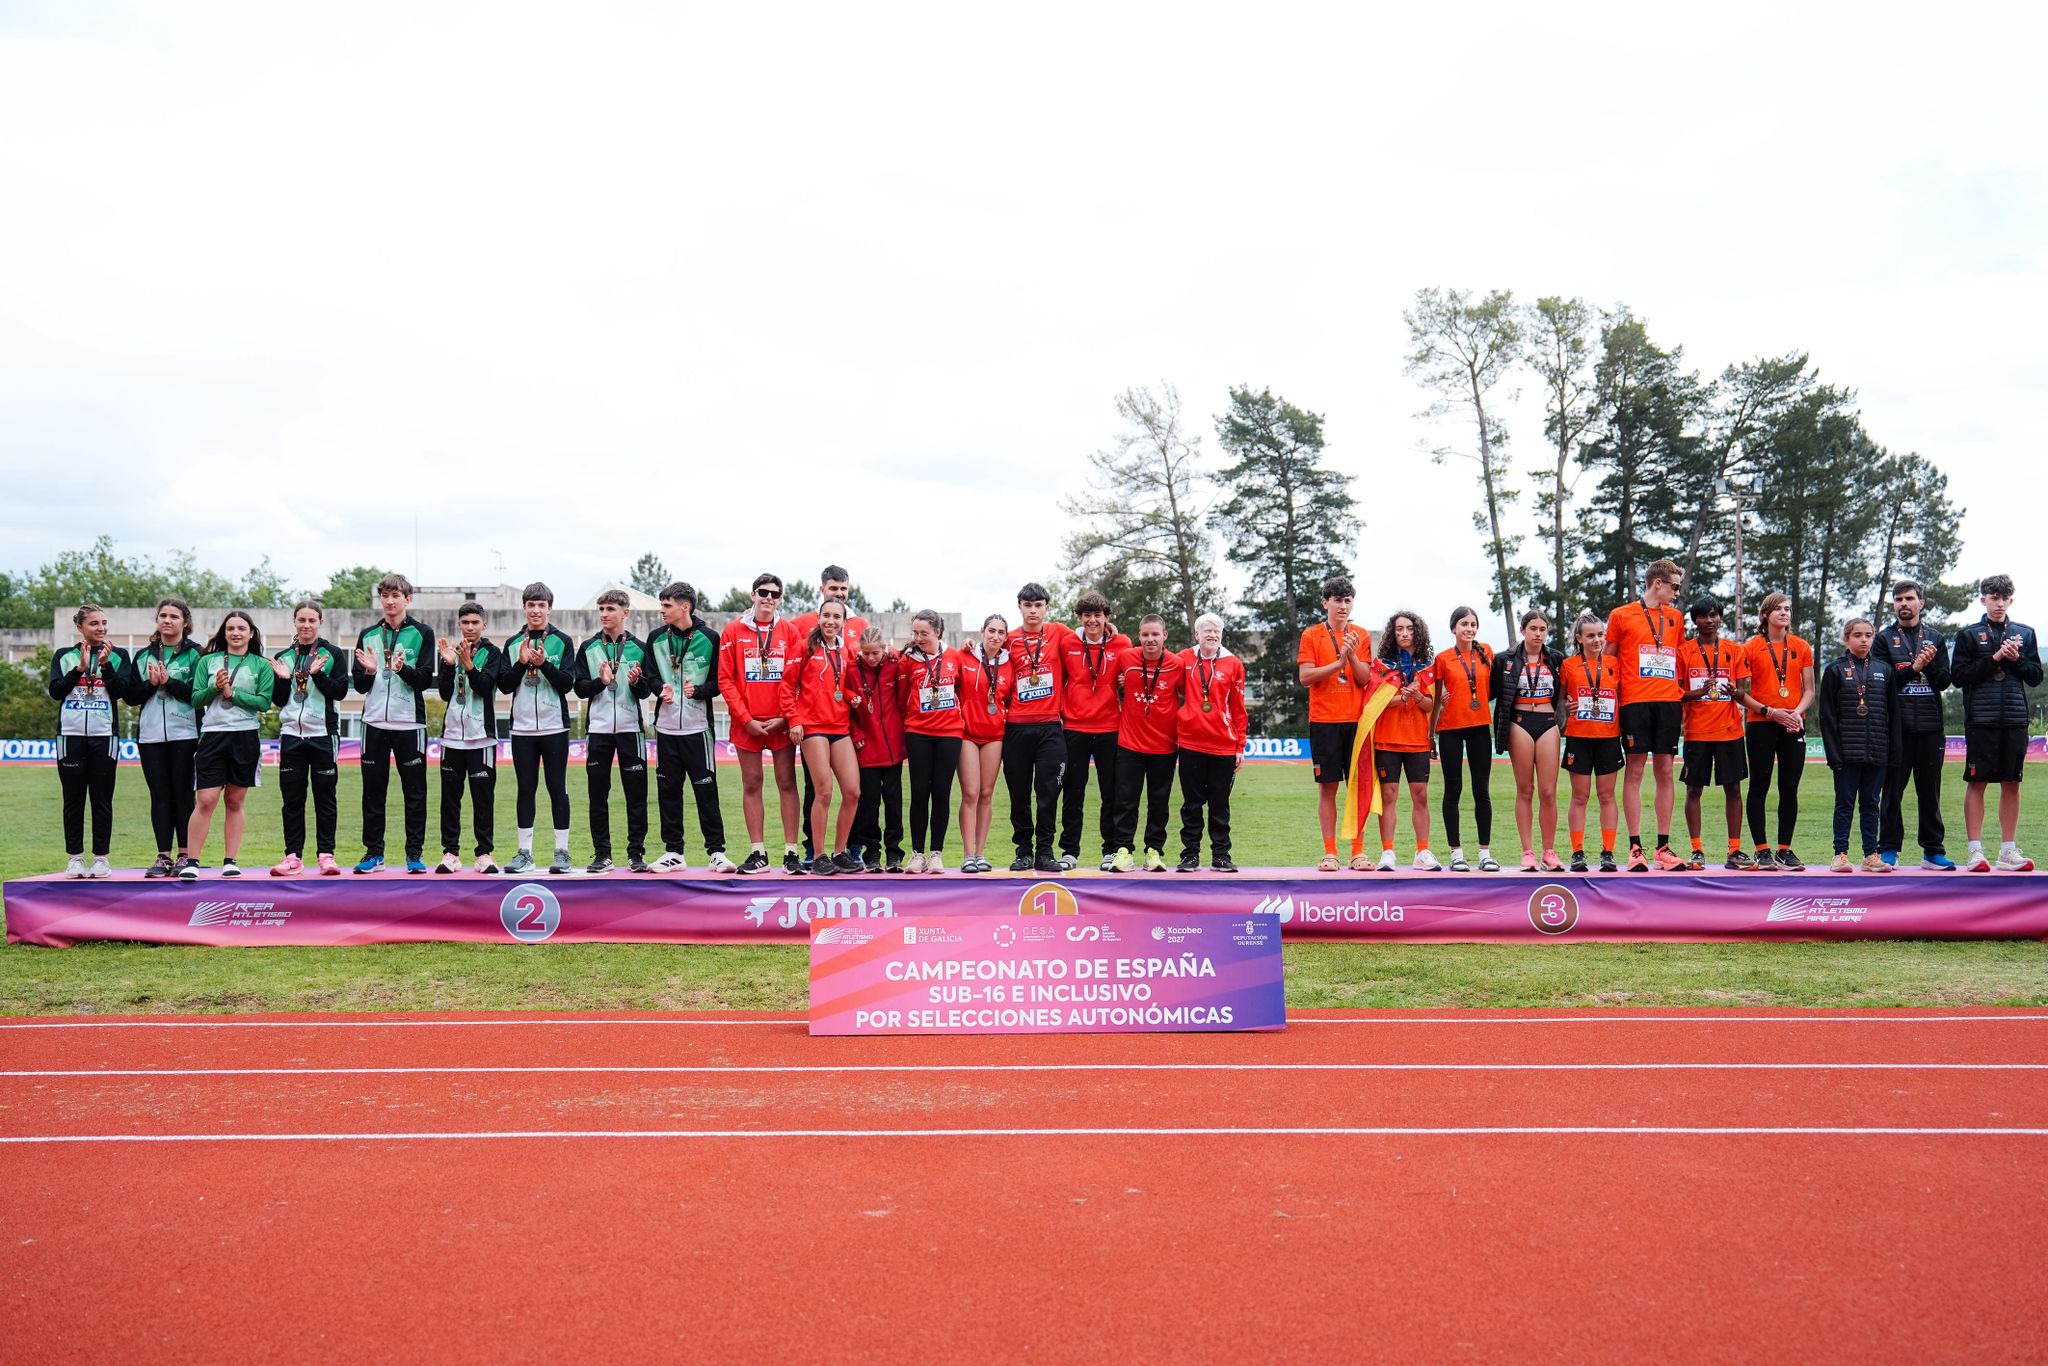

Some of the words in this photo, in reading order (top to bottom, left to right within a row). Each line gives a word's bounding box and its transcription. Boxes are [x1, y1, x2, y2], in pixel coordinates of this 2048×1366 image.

[1651, 668, 1675, 678] Joma
[1243, 738, 1302, 757] oma
[1034, 890, 1058, 915] 1
[1300, 900, 1404, 922] Iberdrola
[1541, 894, 1567, 926] 3
[514, 895, 547, 932] 2
[919, 927, 946, 935] XUNTA
[919, 935, 929, 943] DE
[931, 935, 963, 943] GALICIA
[1167, 926, 1203, 934] Xacobeo
[885, 960, 1068, 981] CAMPEONATO
[1075, 959, 1109, 979] DE
[1116, 952, 1216, 978] ESPAÑA
[928, 985, 1006, 1004] SUB-16
[1012, 985, 1024, 1003] E
[1031, 983, 1152, 1002] INCLUSIVO
[856, 1010, 901, 1028] POR
[907, 1008, 1063, 1028] SELECCIONES
[1067, 1002, 1234, 1026] AUTONÓMICAS
